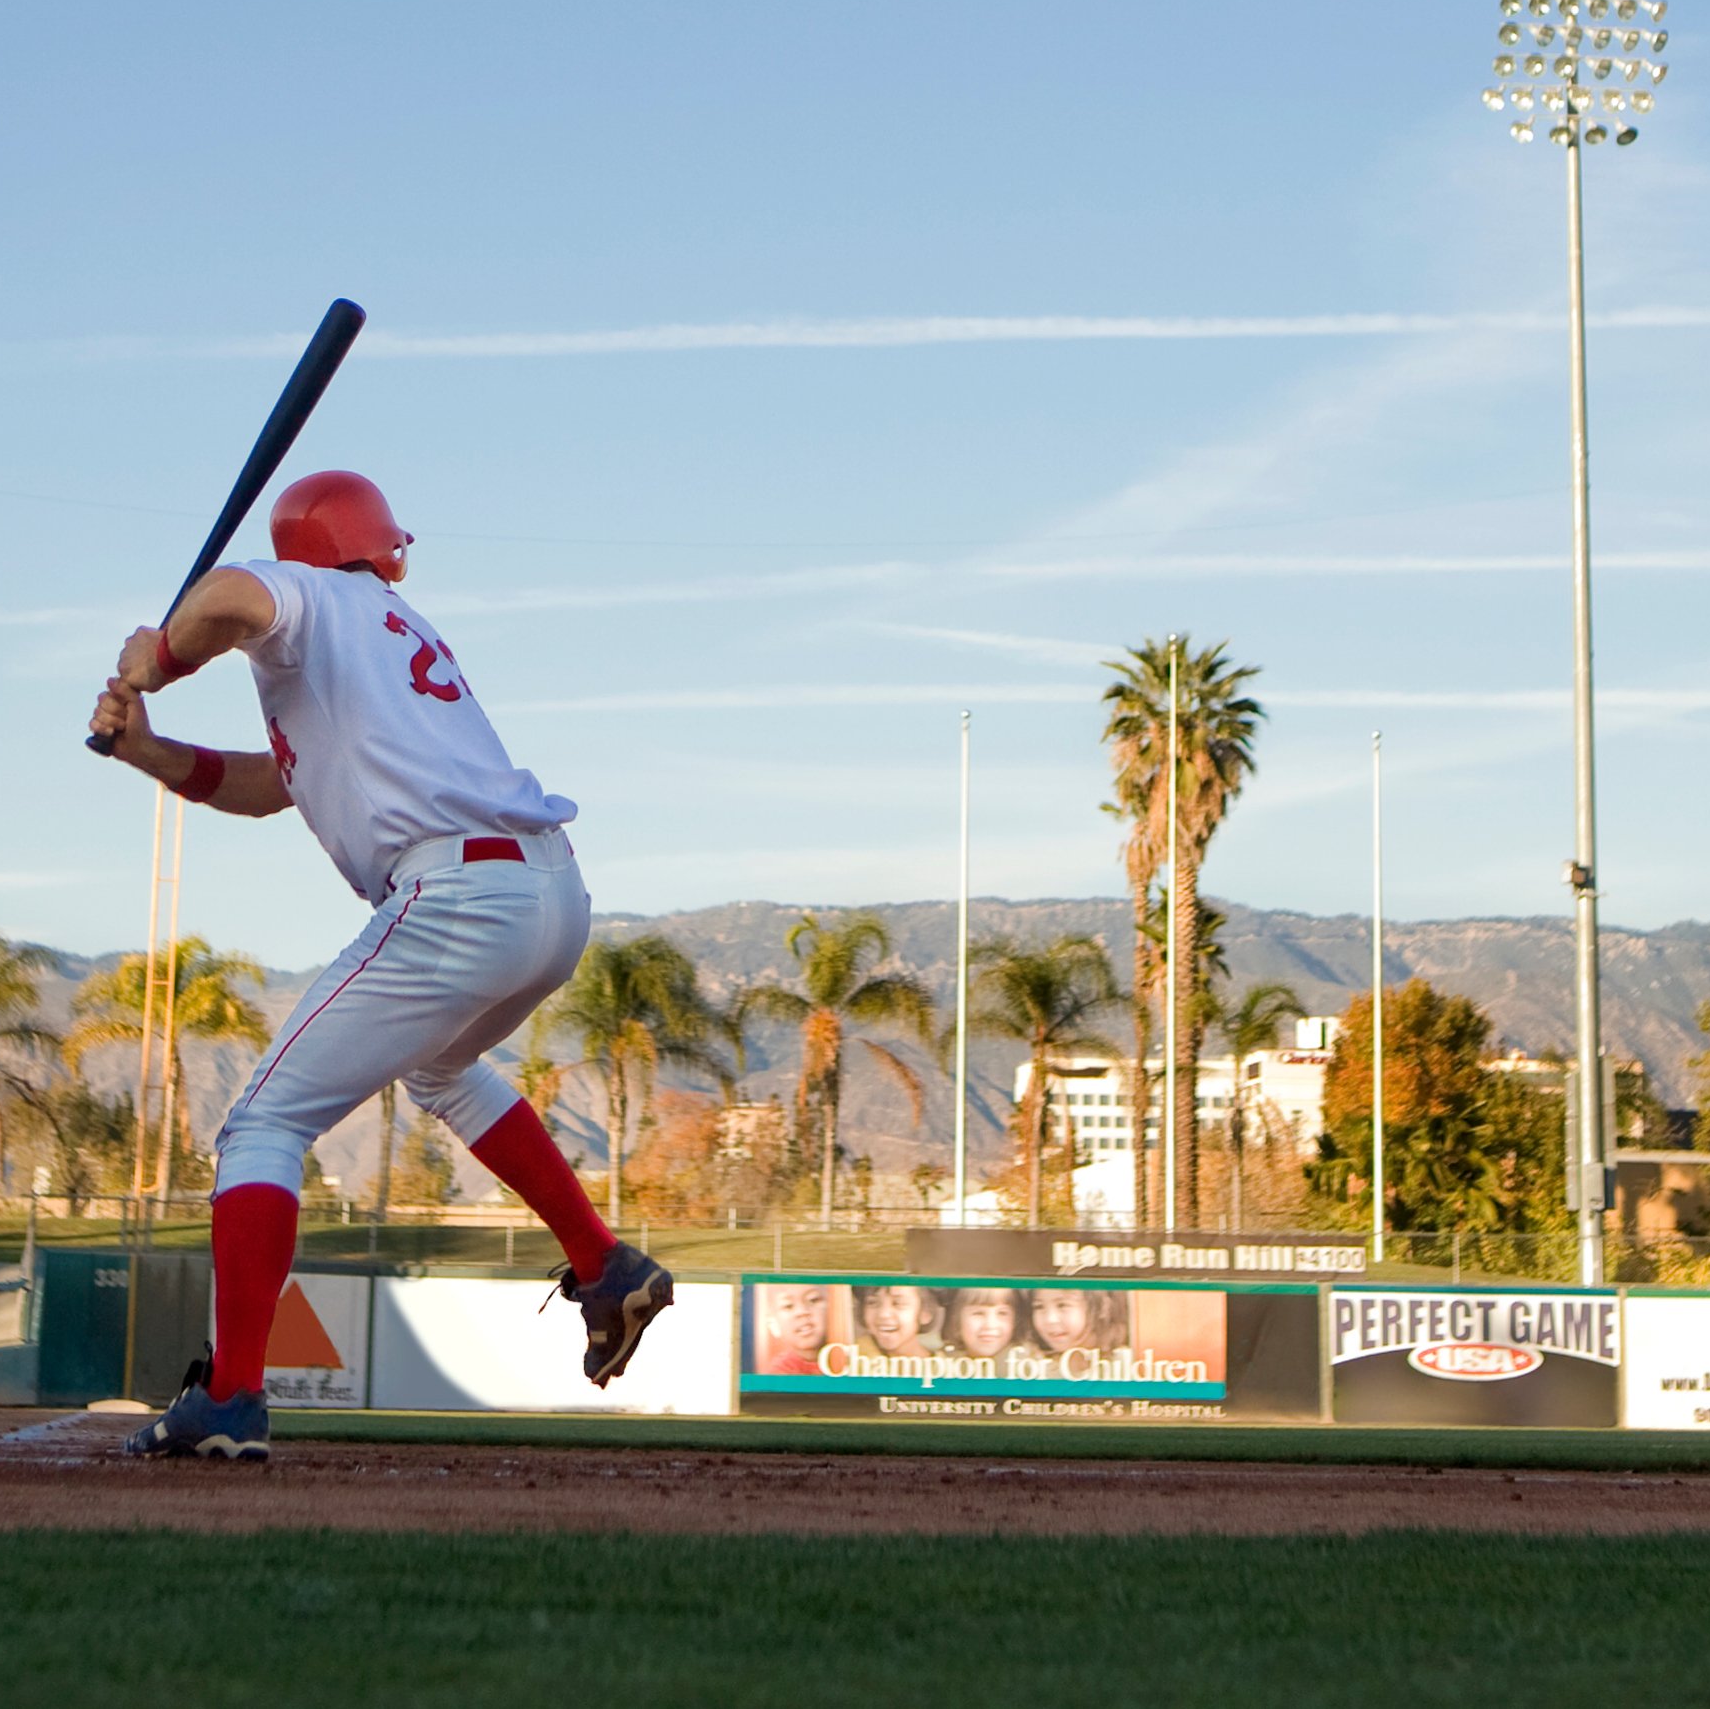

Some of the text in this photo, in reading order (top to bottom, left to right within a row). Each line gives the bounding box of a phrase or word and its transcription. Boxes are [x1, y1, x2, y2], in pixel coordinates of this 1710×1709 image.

[1052, 1241, 1155, 1271] Home
[1160, 1243, 1229, 1270] Run
[1234, 1244, 1294, 1272] Hill
[1335, 1298, 1615, 1359] PERFECT GAME
[817, 1343, 1209, 1388] Champion for Children
[1434, 1346, 1517, 1373] USA
[878, 1396, 998, 1415] UNIVERSITY
[1131, 1400, 1227, 1419] HOSPITAL
